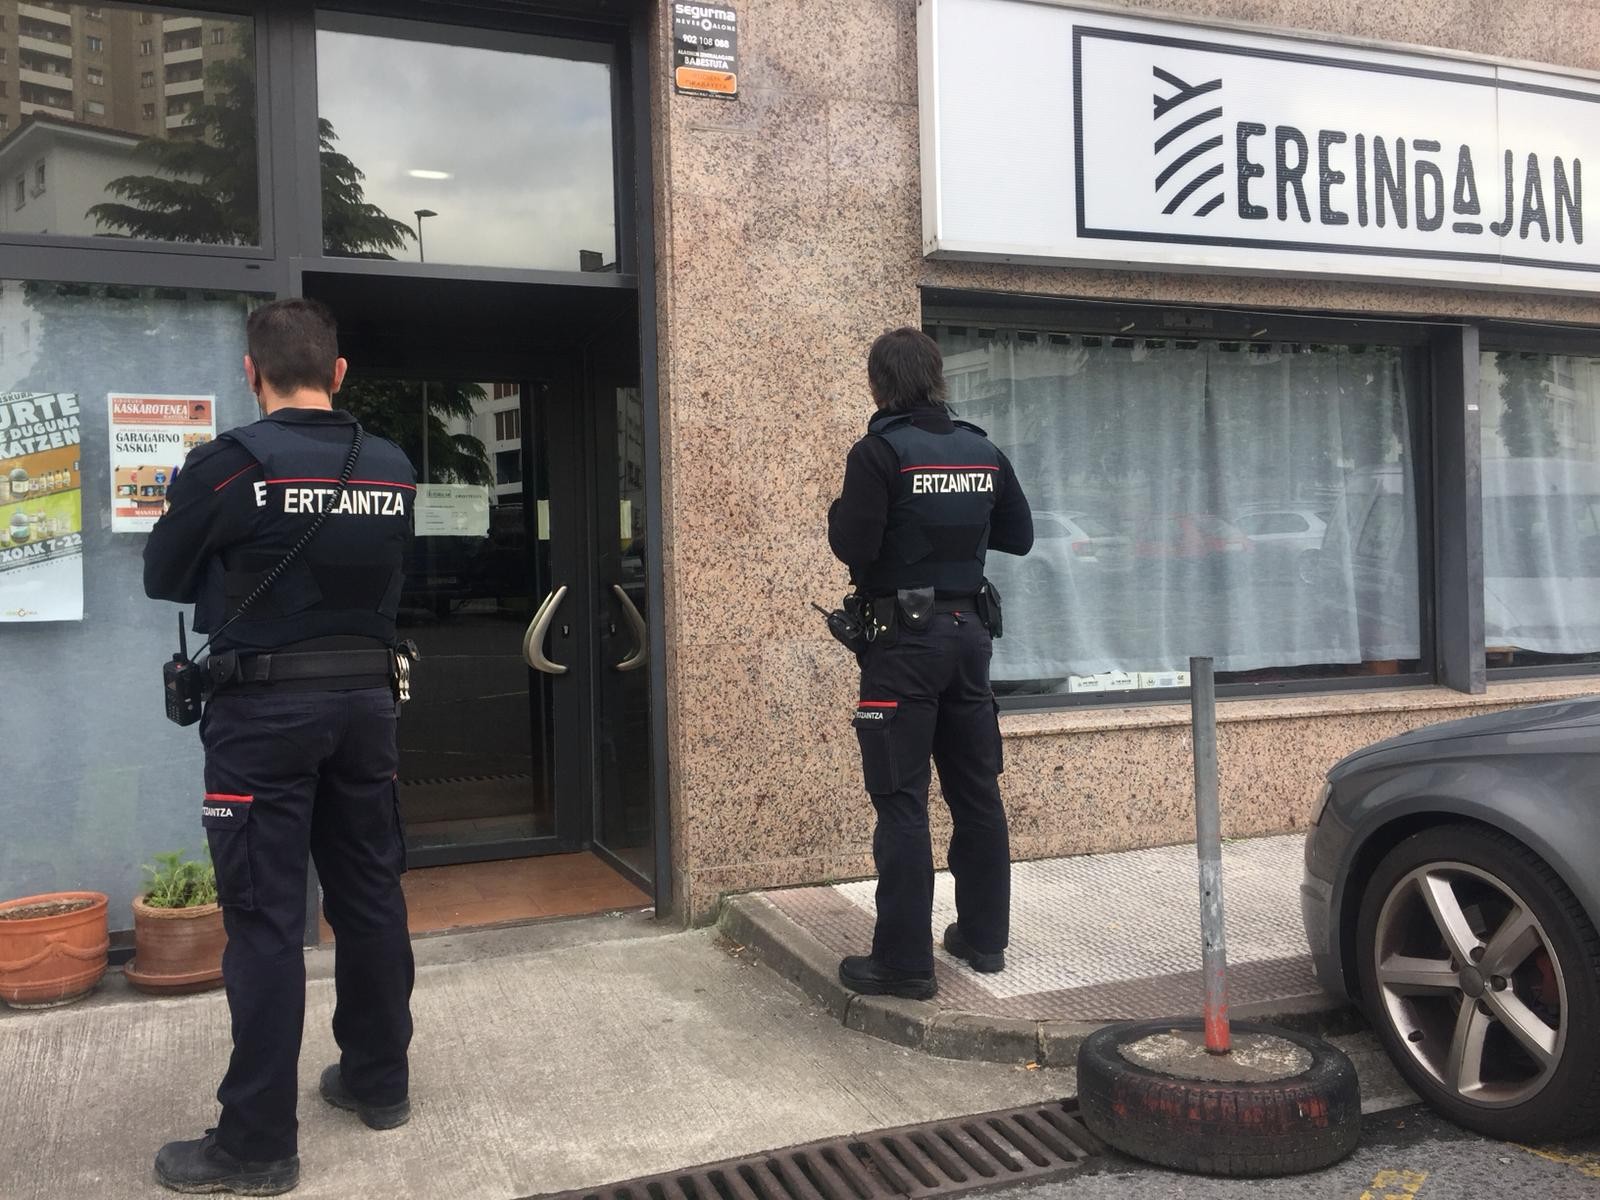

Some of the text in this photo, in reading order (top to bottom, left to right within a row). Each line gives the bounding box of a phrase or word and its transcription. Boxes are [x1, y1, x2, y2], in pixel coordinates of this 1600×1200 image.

[675, 4, 736, 21] segurma
[712, 23, 736, 32] ALONE
[682, 34, 697, 44] 902
[699, 36, 714, 46] 108
[0, 392, 33, 403] SKURA
[113, 403, 188, 415] KASKAROTENEA
[9, 415, 80, 441] DUGUNA
[115, 432, 180, 443] GARAGARNO
[115, 443, 158, 453] SASKIA!
[912, 473, 994, 494] ERTZAINTZA
[284, 488, 405, 516] ERTZAINTZA
[46, 533, 83, 551] 7-22
